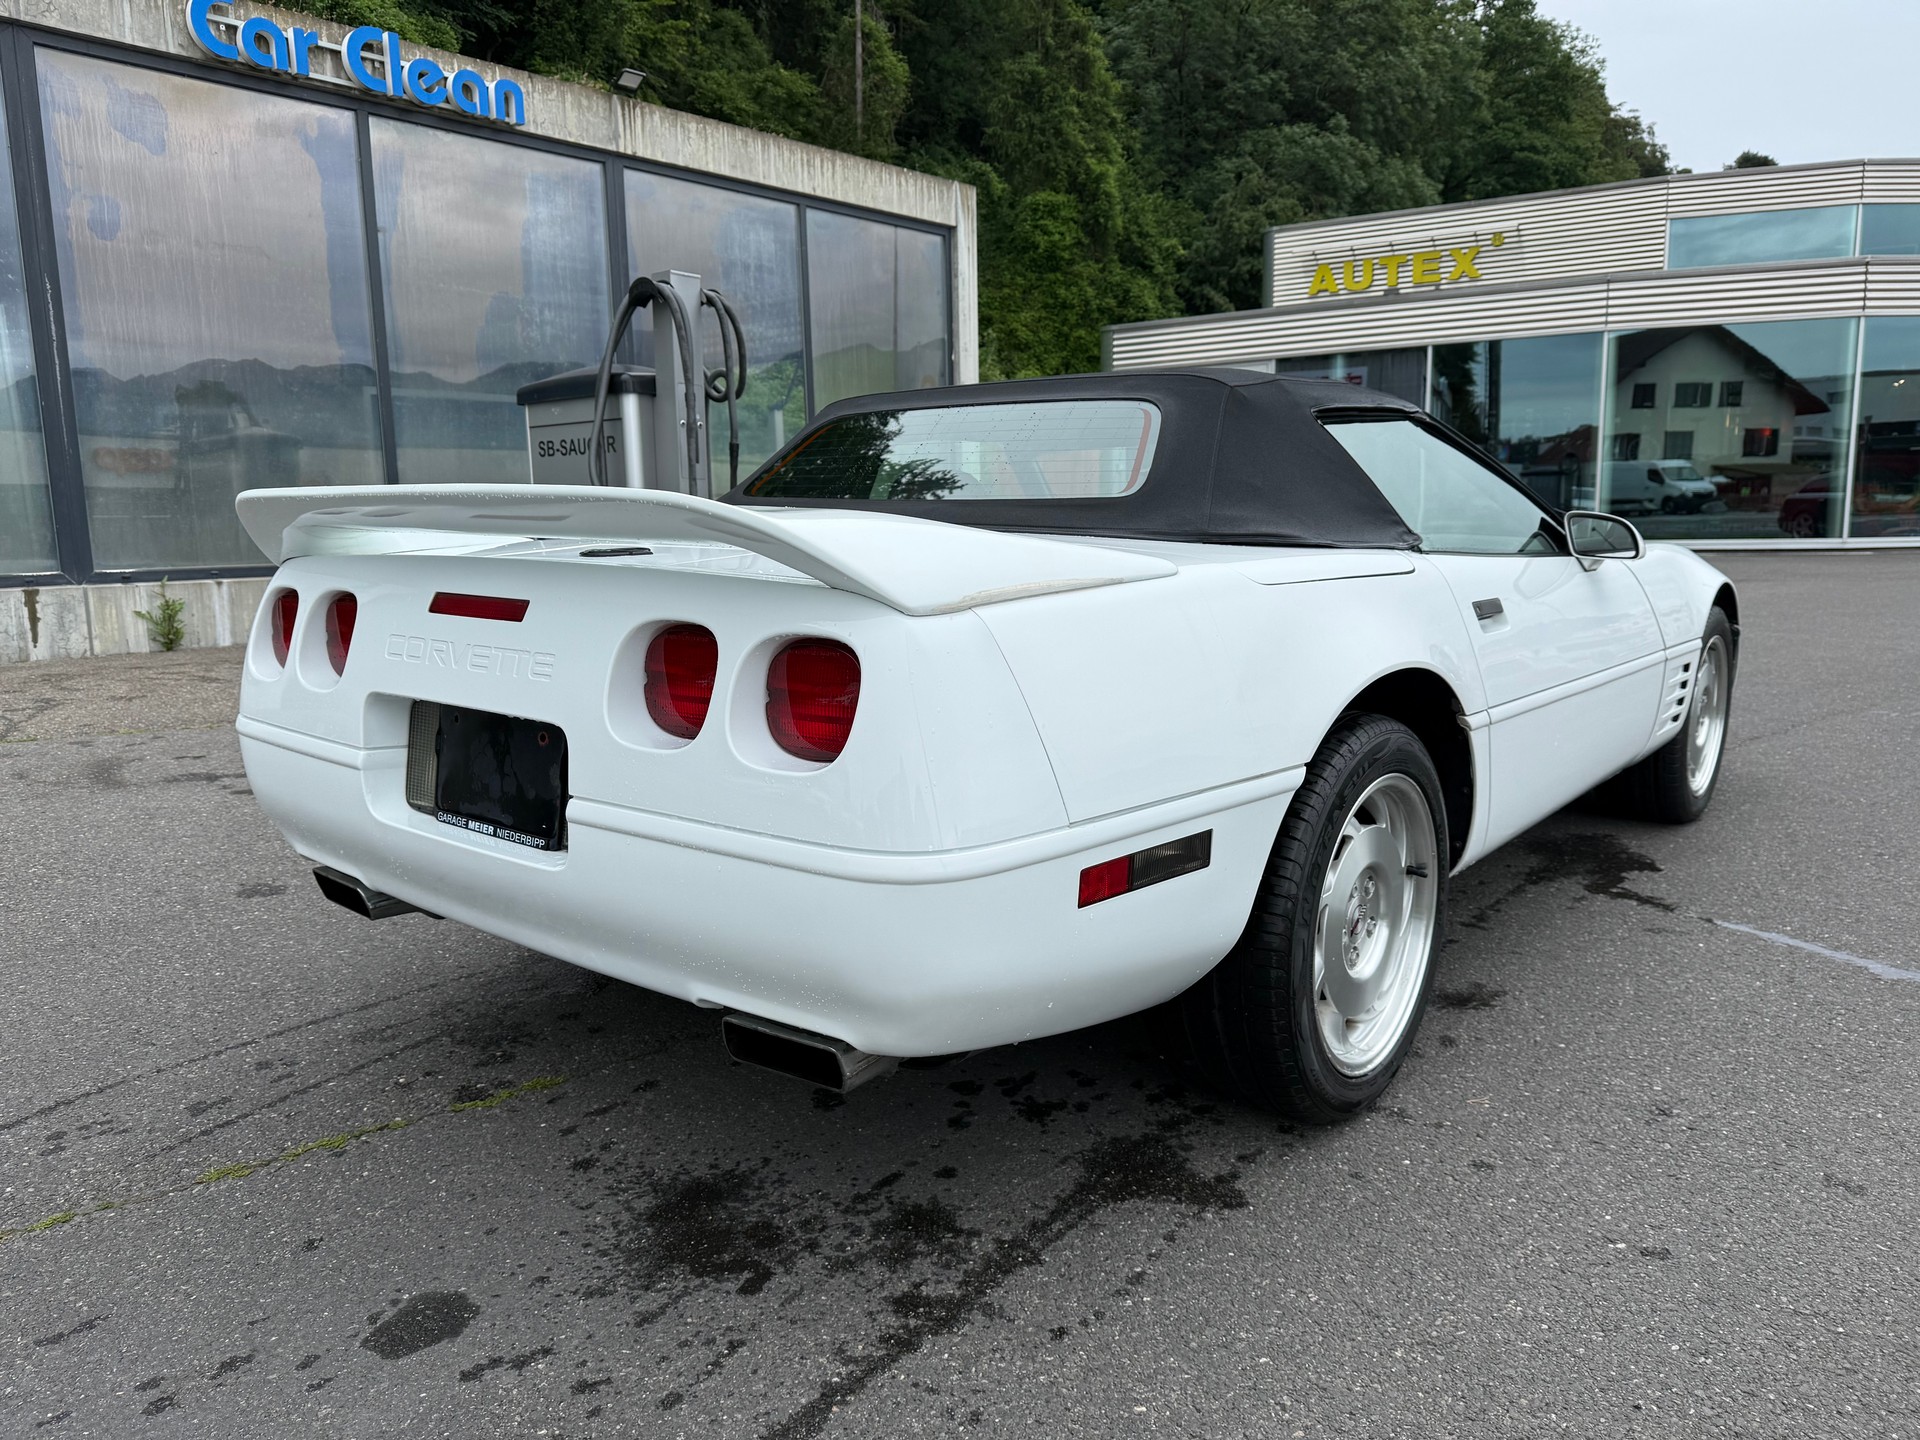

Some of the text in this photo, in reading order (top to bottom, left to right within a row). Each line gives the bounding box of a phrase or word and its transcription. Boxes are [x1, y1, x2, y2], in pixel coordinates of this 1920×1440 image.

[186, 0, 525, 126] Car Clean
[1308, 246, 1483, 296] AUTEX
[538, 436, 617, 457] SB-SAUR
[385, 633, 556, 682] CORVETTE
[437, 811, 545, 849] GARAGE MEIER NIEDERBIPP
